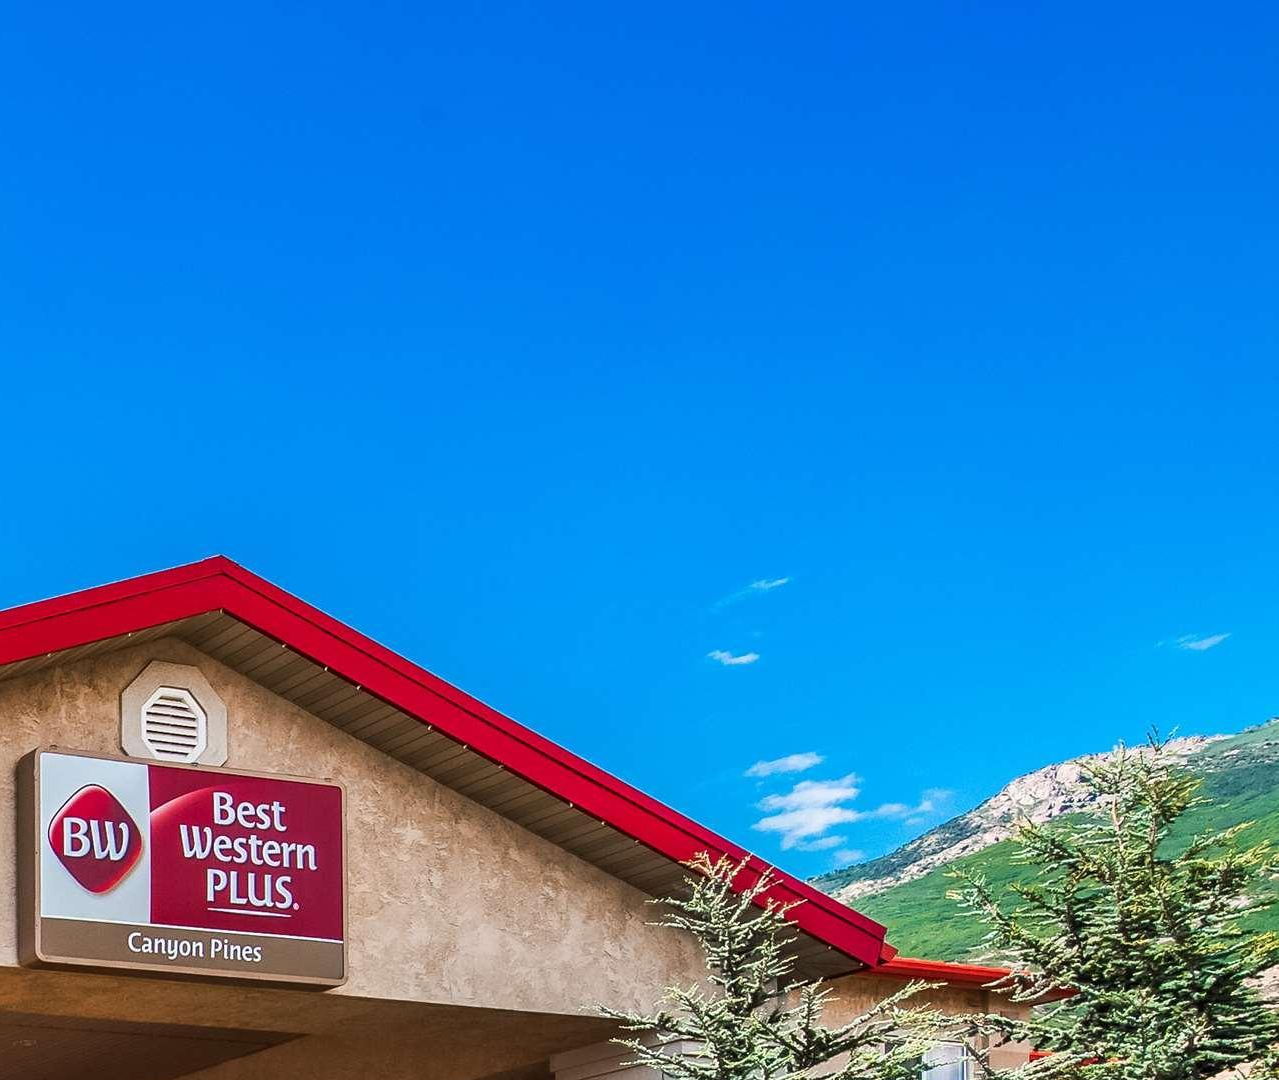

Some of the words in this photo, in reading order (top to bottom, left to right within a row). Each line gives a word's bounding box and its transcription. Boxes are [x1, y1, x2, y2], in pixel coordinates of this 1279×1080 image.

[213, 792, 287, 832] Best
[62, 817, 131, 861] BW
[179, 824, 318, 871] Western
[127, 931, 205, 961] Canyon
[210, 938, 263, 963] Pines
